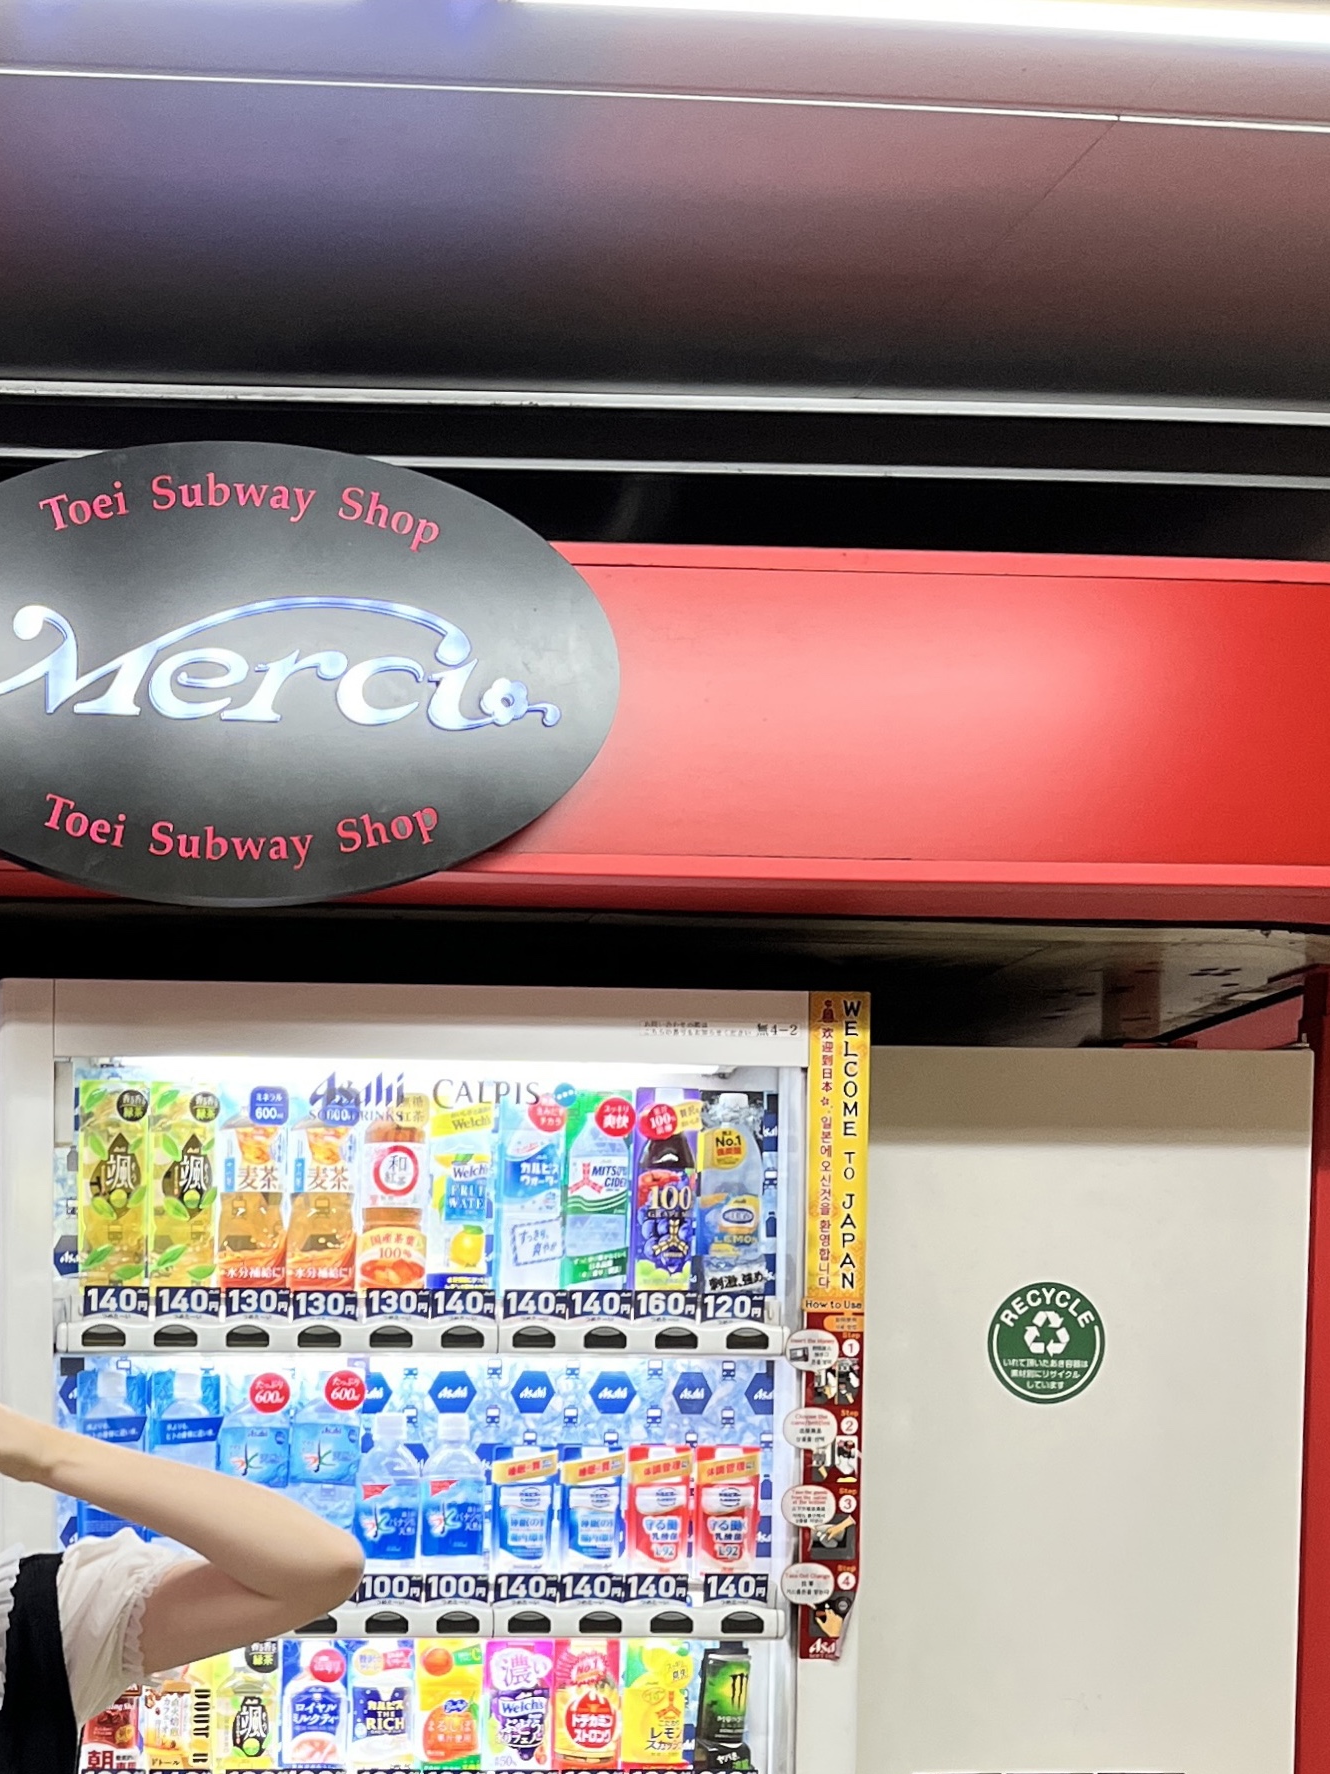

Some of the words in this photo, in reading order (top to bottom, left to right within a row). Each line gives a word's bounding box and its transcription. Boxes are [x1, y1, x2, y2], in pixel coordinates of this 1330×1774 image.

[39, 482, 129, 532] Toei
[152, 473, 315, 521] Subway
[338, 488, 439, 553] Shop
[44, 793, 125, 846] Toei
[150, 821, 313, 869] Subway
[338, 805, 439, 853] Shop
[842, 1000, 861, 1137] WELCOME
[309, 1071, 404, 1108] Asahi
[433, 1079, 540, 1109] CALPIS
[715, 1135, 741, 1147] No.1
[843, 1152, 855, 1180] TO
[238, 1167, 279, 1190] 麦茶
[308, 1167, 349, 1190] 麦茶
[649, 1185, 692, 1210] 100
[839, 1193, 857, 1290] JAPAN
[379, 1248, 412, 1259] 100%
[806, 1301, 828, 1309] How
[831, 1301, 841, 1309] to
[844, 1301, 862, 1309] Use
[1000, 1287, 1095, 1328] RECYCLE
[848, 1343, 854, 1353] 1
[1026, 1381, 1064, 1389] しています
[438, 1387, 468, 1399] Asahi
[519, 1386, 548, 1400] Asahi
[598, 1386, 628, 1400] Asahi
[679, 1386, 706, 1400] Asahi
[845, 1421, 853, 1431] 2
[844, 1498, 853, 1510] 3
[841, 1574, 852, 1586] 4
[295, 1703, 338, 1713] ロイヤル
[377, 1710, 395, 1718] THE
[366, 1717, 404, 1730] RICH
